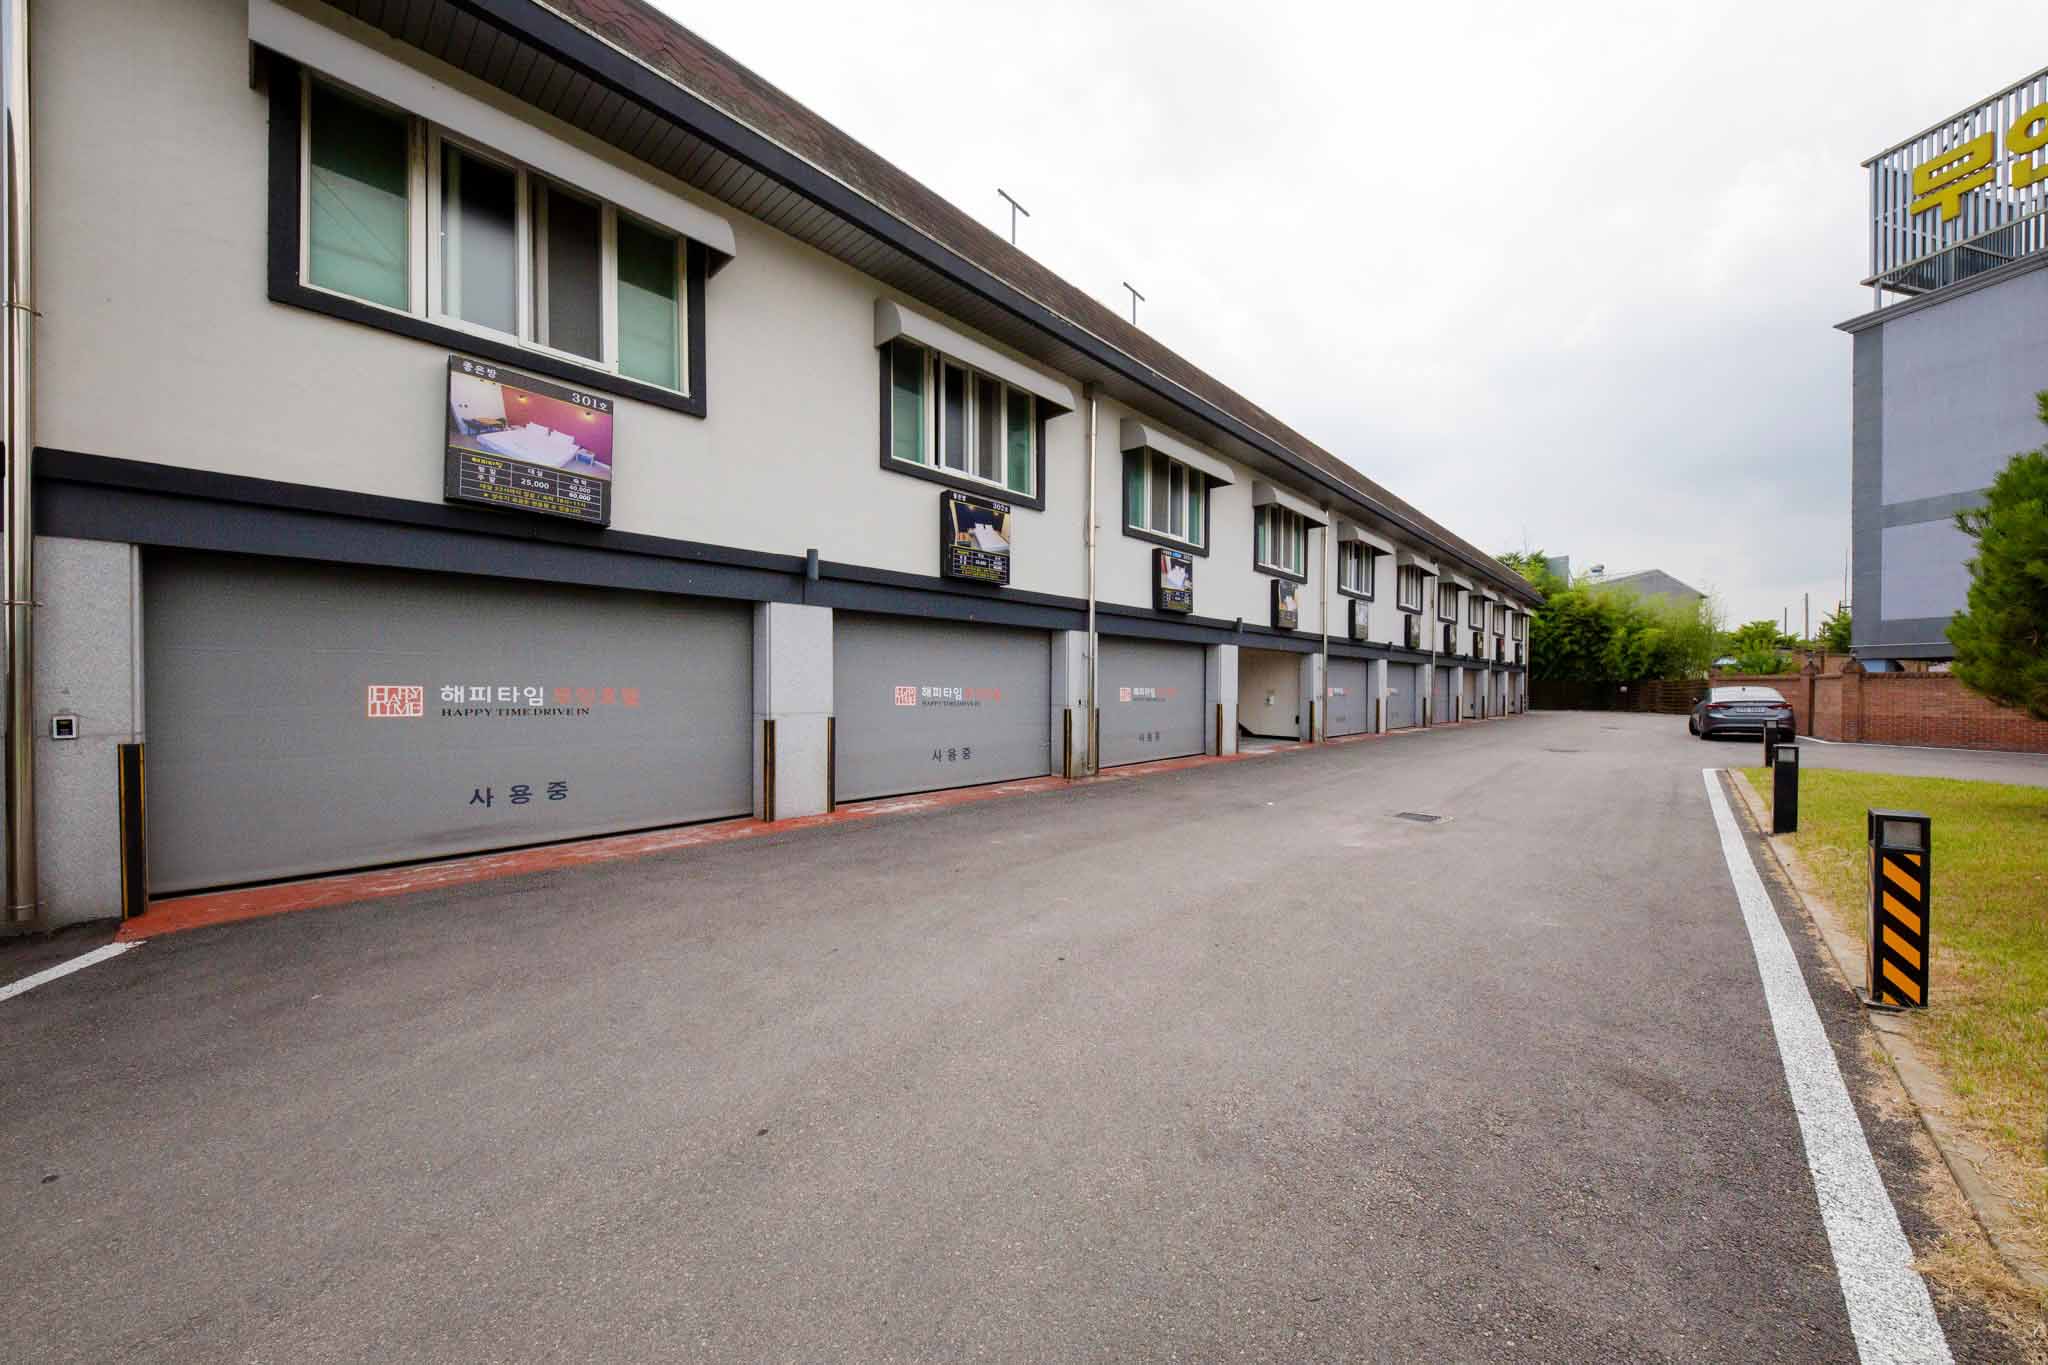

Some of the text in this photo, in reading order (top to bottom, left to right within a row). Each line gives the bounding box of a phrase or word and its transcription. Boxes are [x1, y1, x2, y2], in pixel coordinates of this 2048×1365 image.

[440, 685, 544, 707] 해피타임
[921, 687, 962, 701] 해피타임
[441, 707, 492, 717] HAPPY
[469, 781, 569, 808] 사용중
